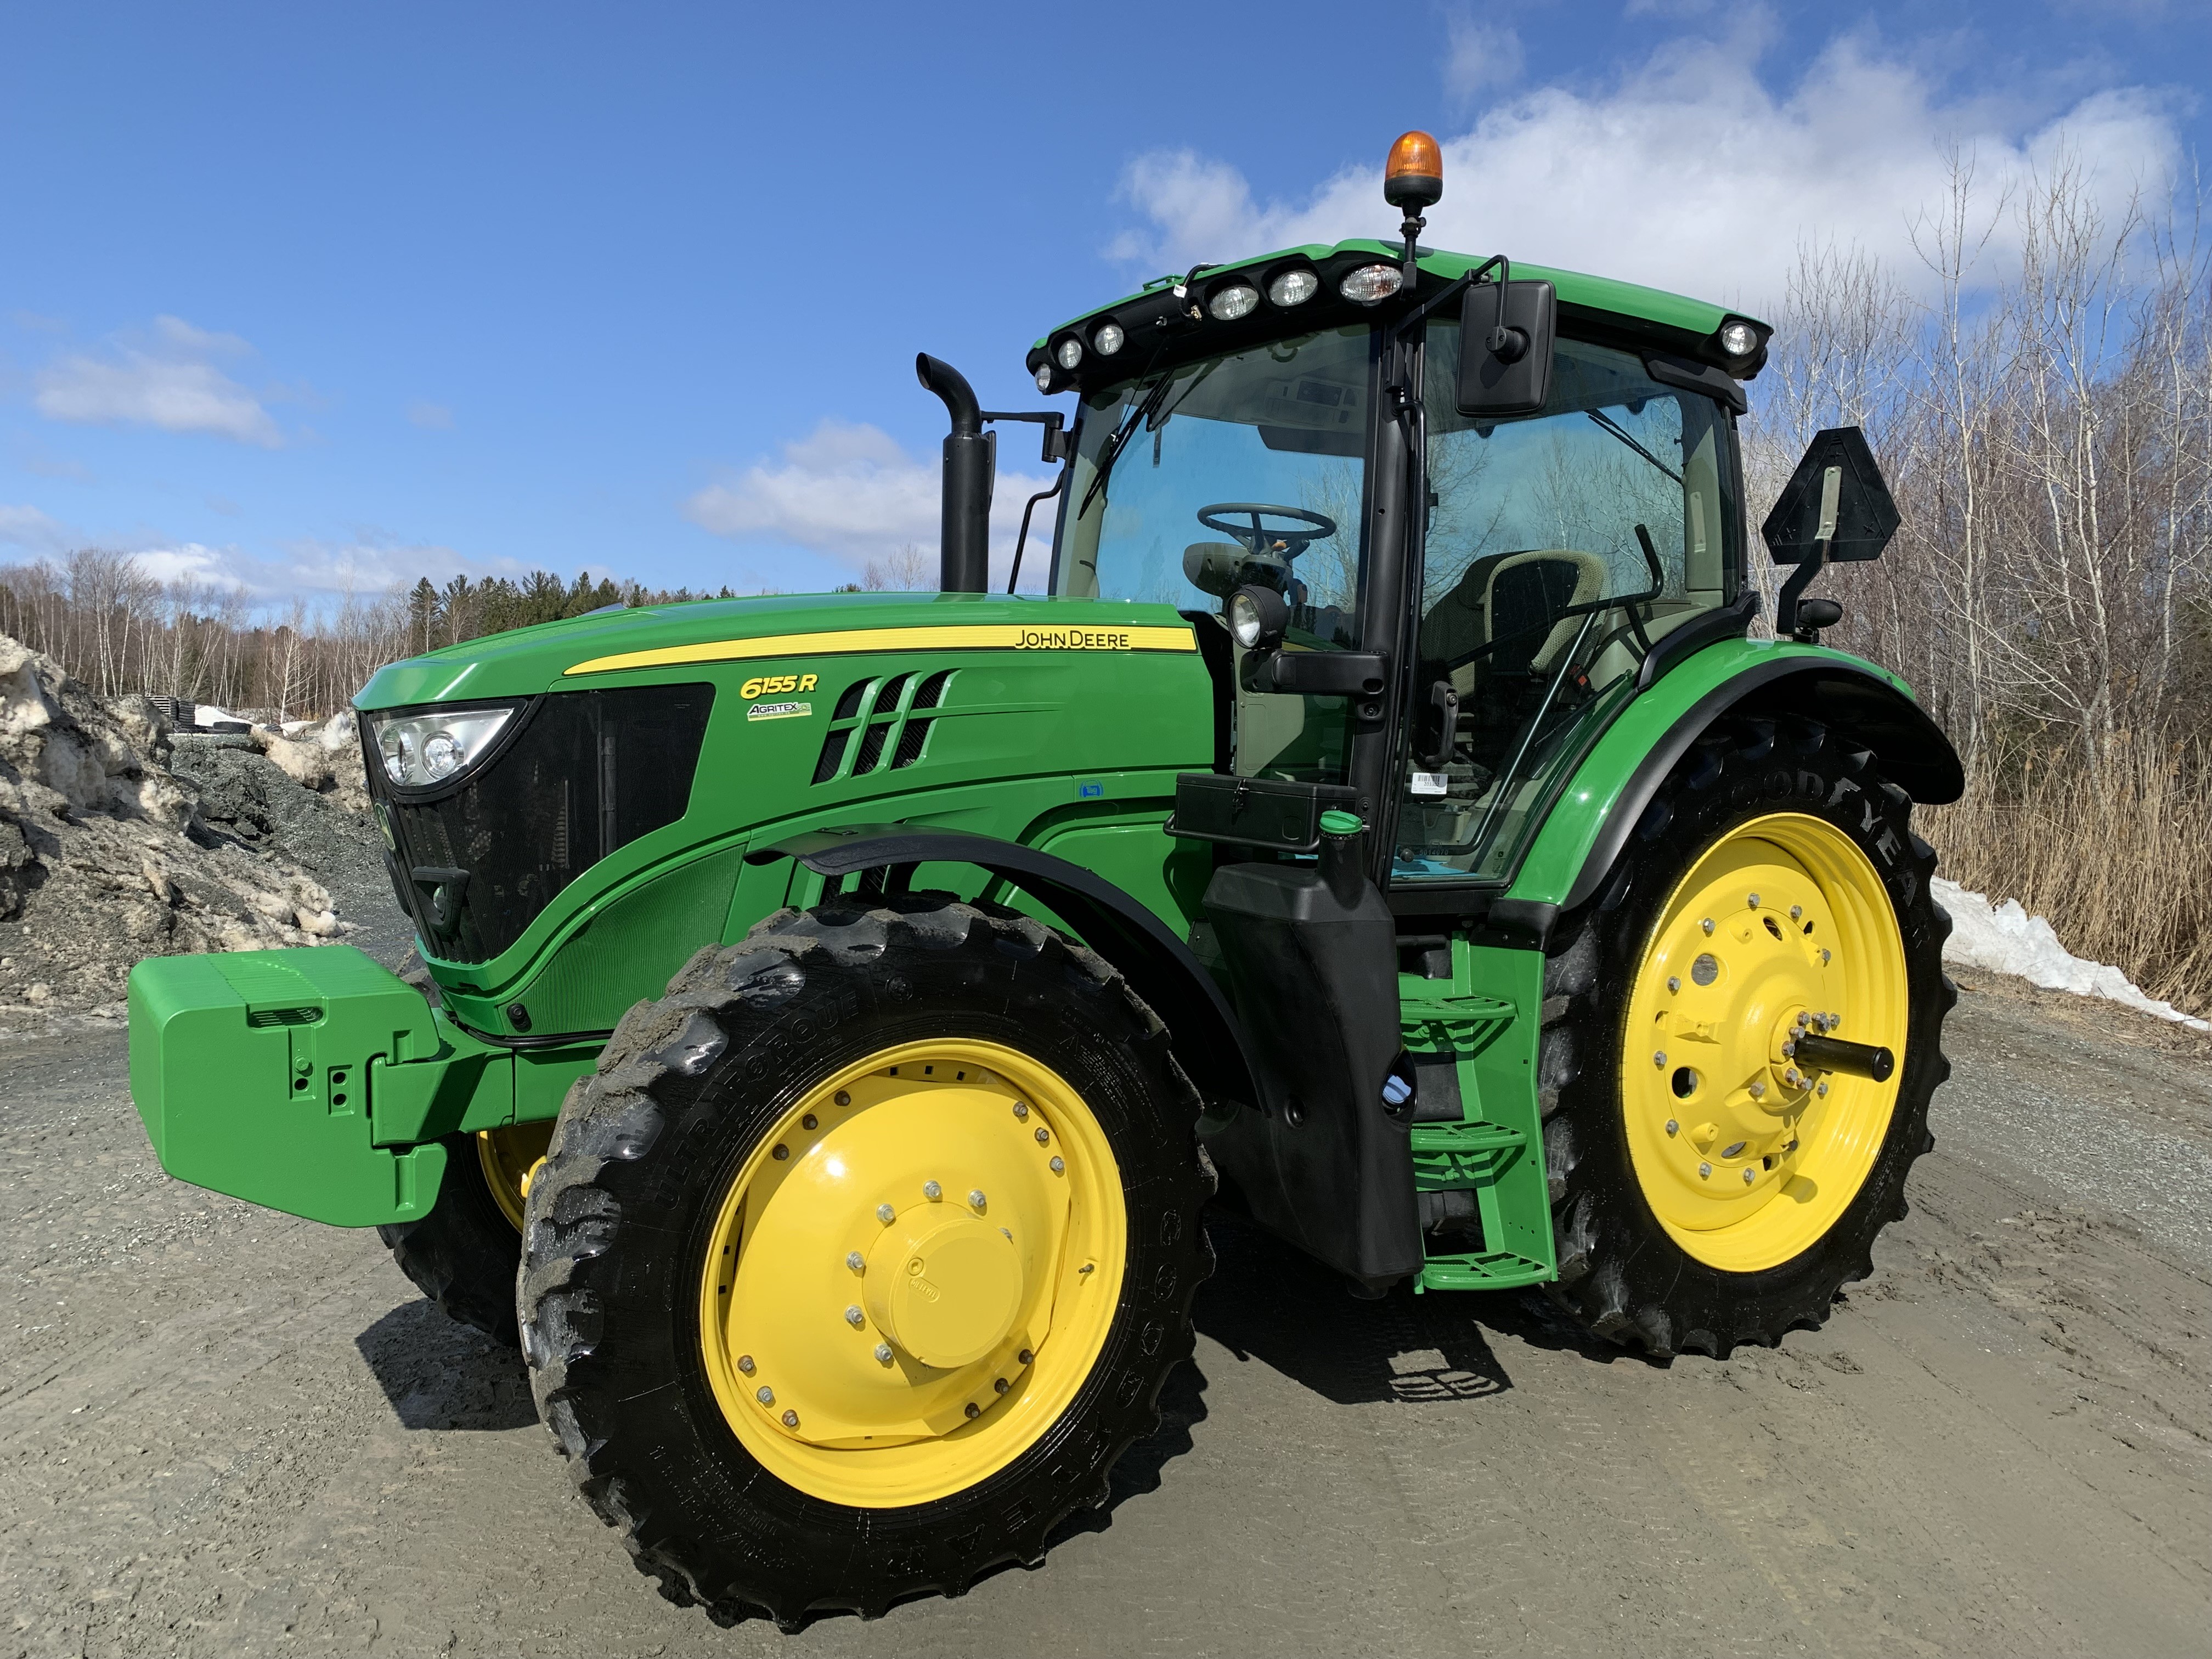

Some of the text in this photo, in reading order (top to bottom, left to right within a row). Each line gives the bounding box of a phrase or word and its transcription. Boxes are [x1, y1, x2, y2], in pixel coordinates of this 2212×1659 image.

[1015, 629, 1130, 647] JOHN DEERE
[740, 674, 819, 700] 6155 R
[749, 703, 798, 714] AGRITEX
